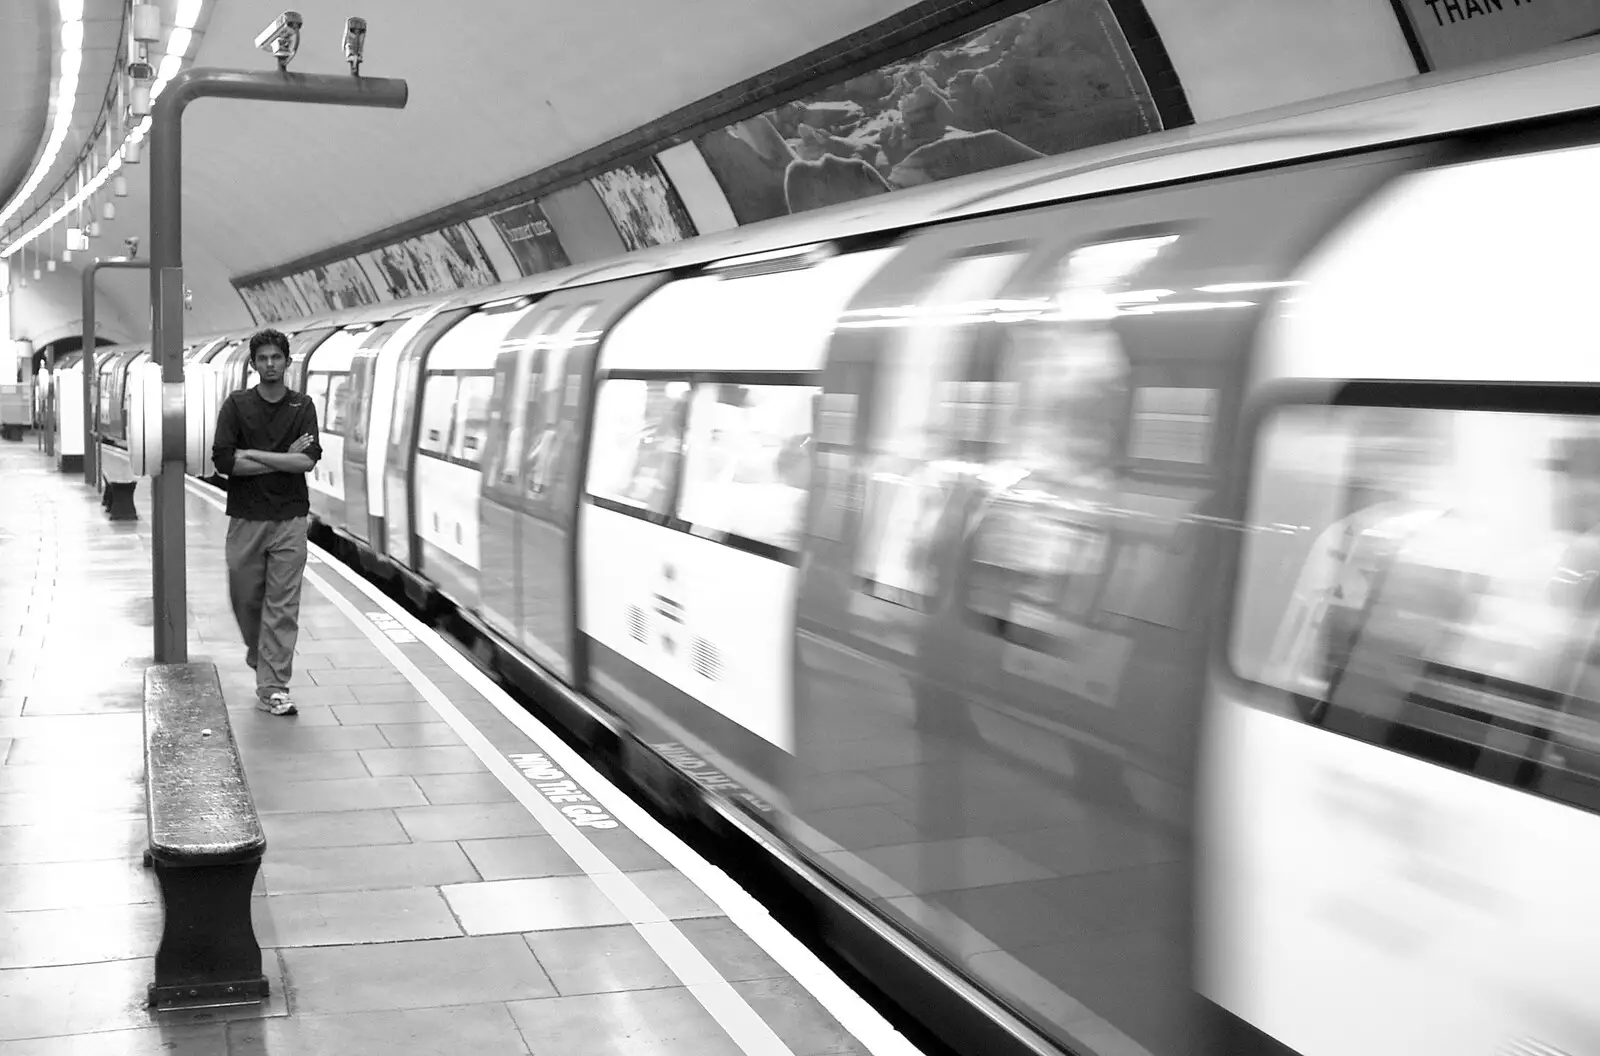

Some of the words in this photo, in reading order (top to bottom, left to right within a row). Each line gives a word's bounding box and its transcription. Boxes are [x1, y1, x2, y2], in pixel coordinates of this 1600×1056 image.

[508, 753, 565, 780] MIND
[536, 780, 591, 803] THE
[561, 804, 619, 829] GAP
